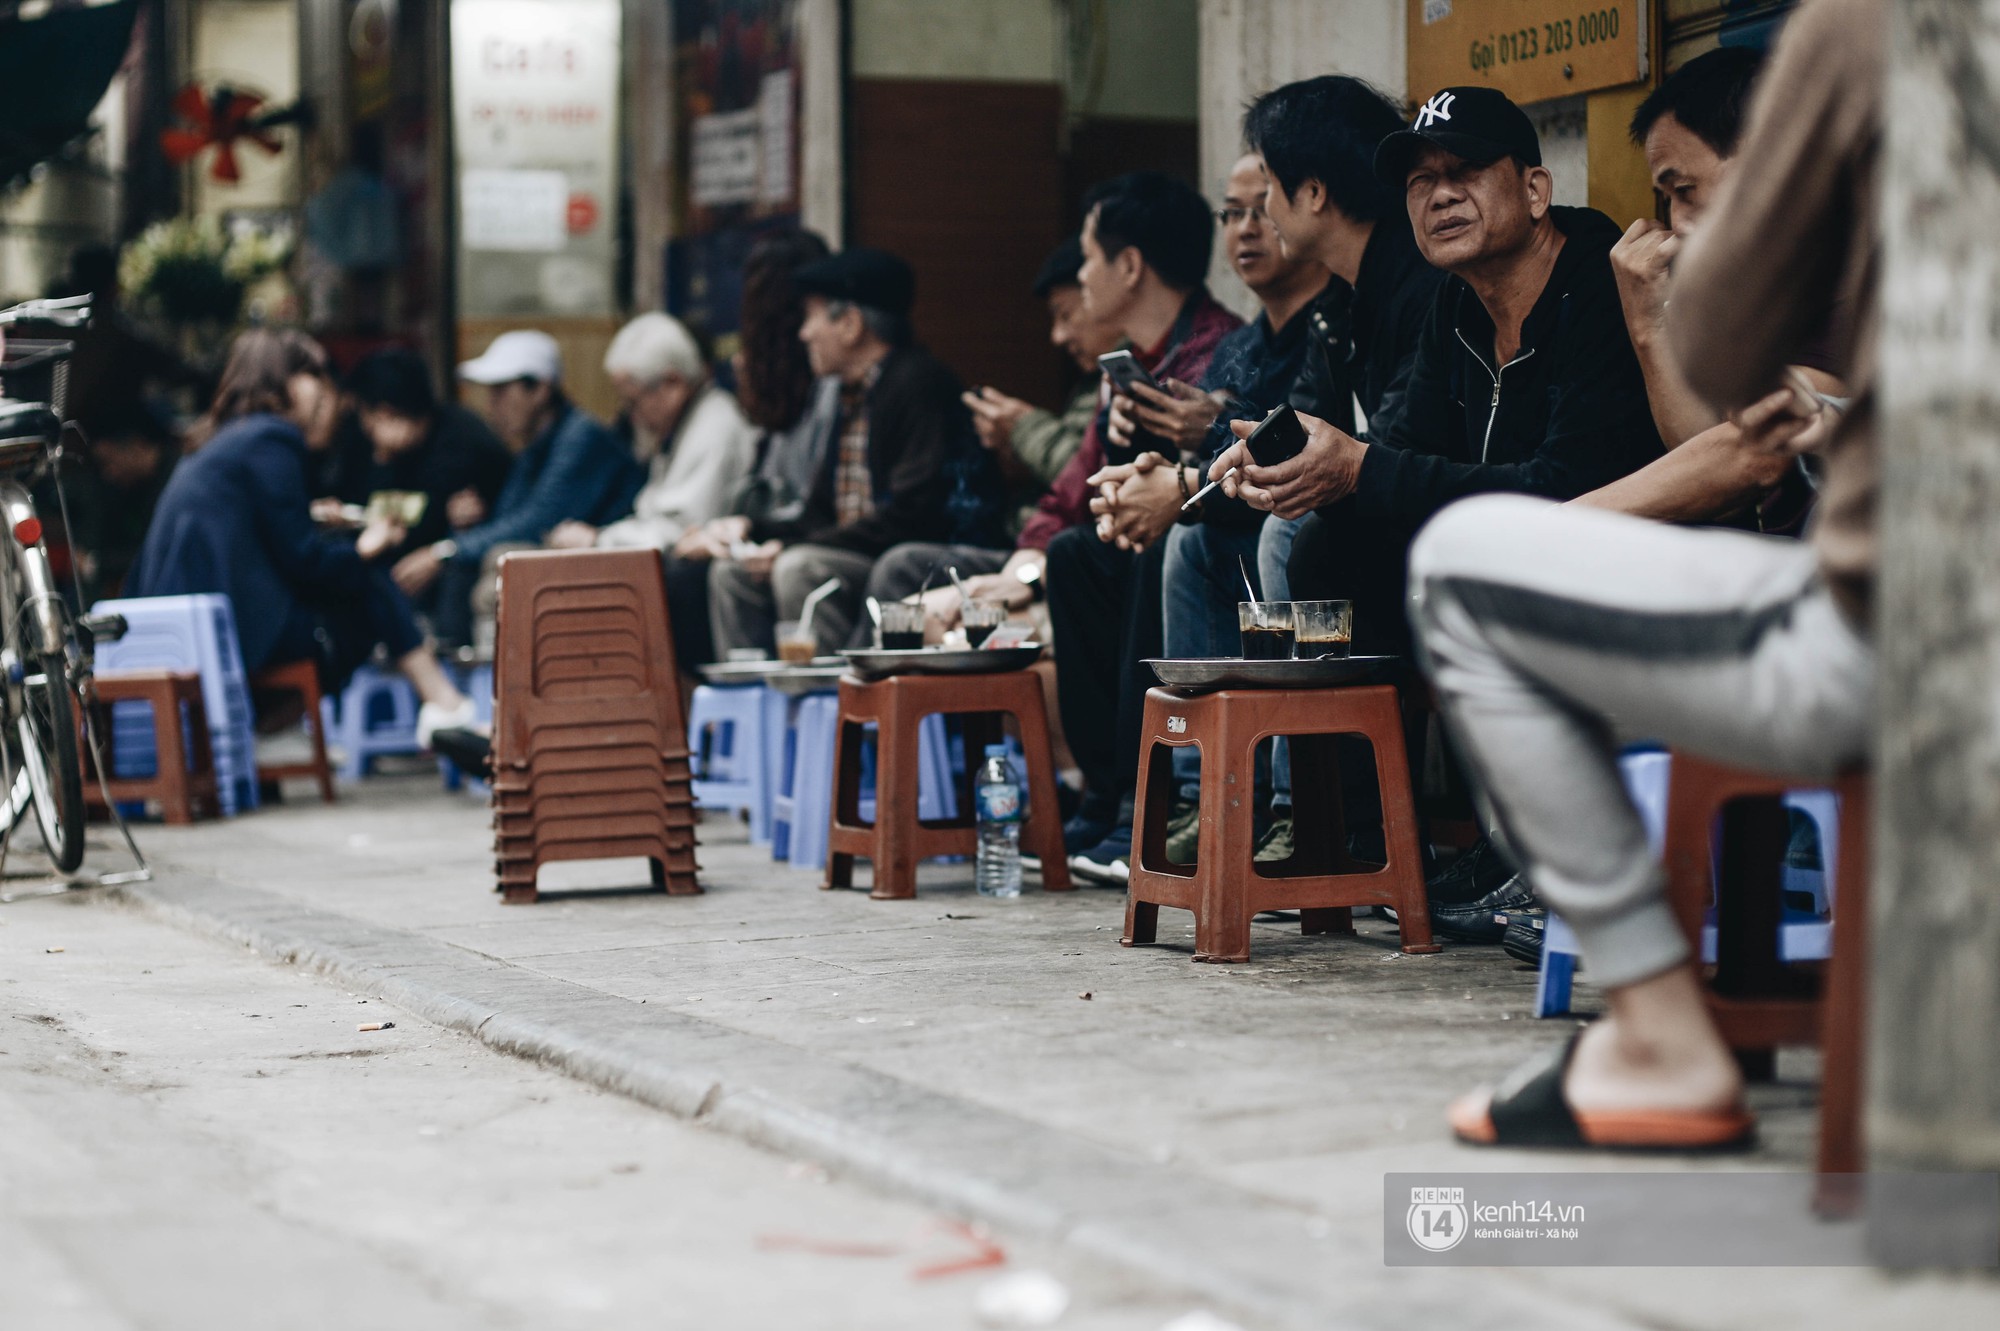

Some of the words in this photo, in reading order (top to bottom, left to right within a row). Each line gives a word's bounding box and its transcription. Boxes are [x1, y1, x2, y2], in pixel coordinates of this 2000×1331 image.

[1470, 33, 1495, 77] Gọi
[1499, 27, 1539, 65] 0123
[1544, 18, 1573, 55] 203
[1578, 7, 1619, 47] 0000
[1413, 91, 1456, 131] NY
